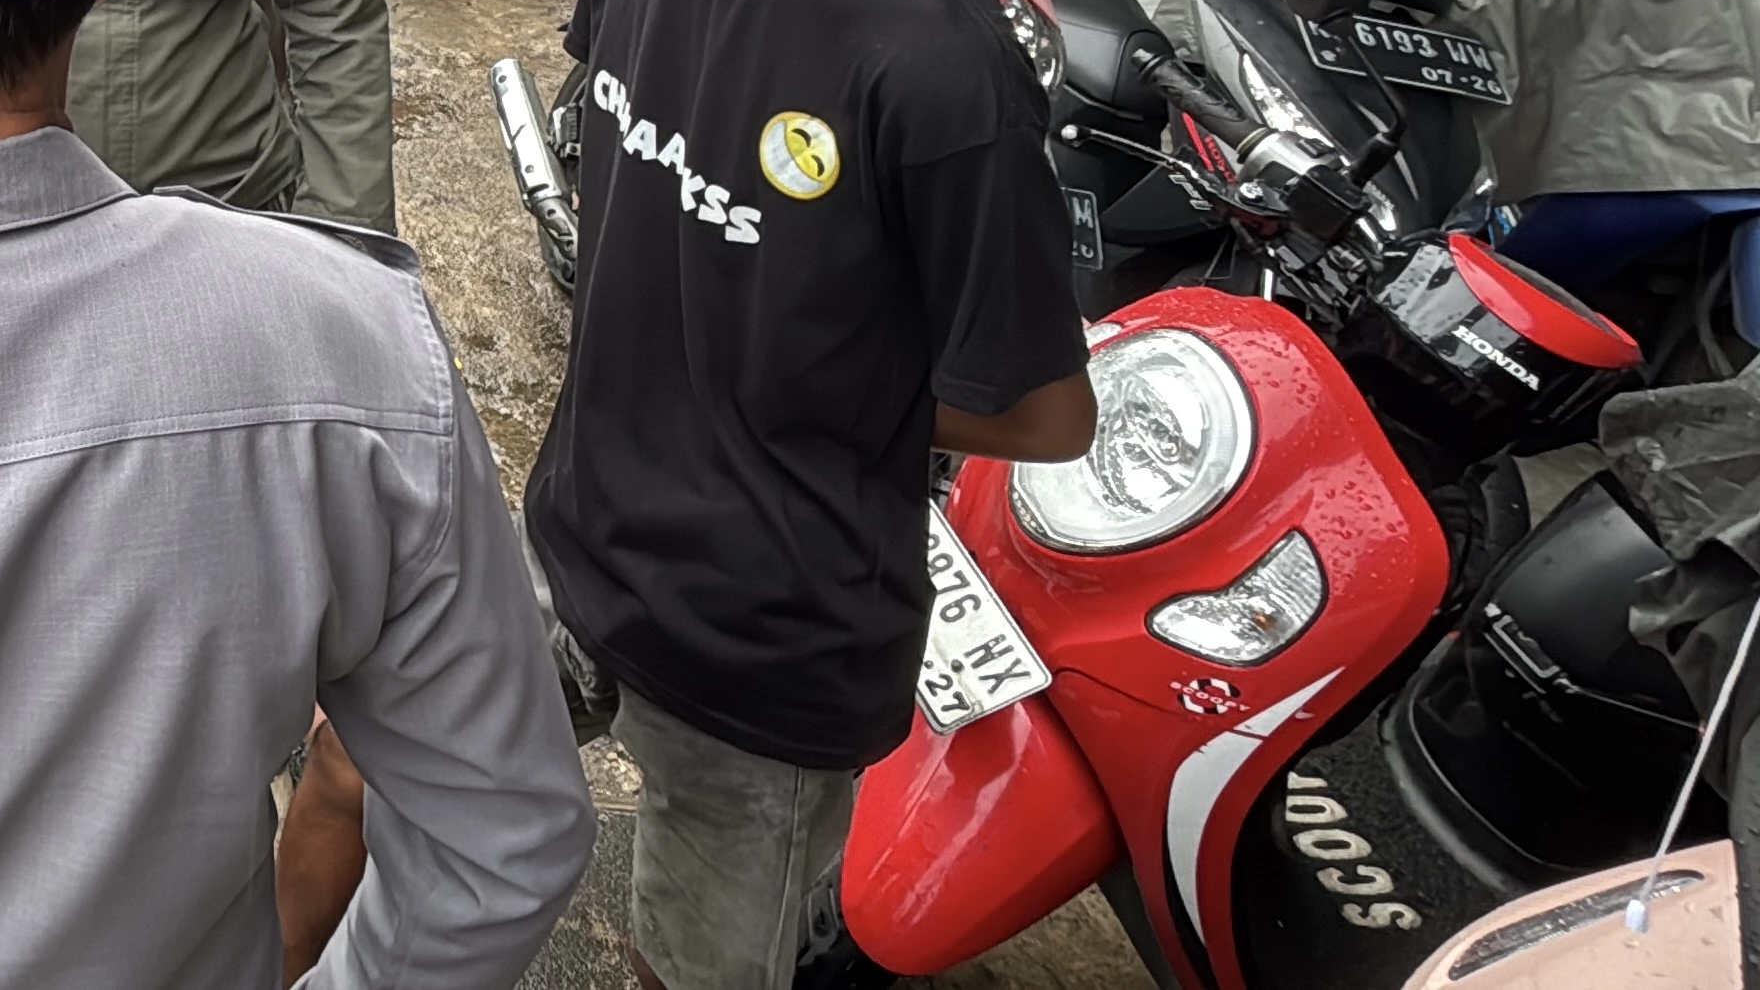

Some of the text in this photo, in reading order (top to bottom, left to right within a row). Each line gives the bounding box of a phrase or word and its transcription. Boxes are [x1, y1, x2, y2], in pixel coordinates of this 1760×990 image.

[1354, 22, 1439, 58] 6193
[1451, 325, 1541, 391] HONDA
[963, 633, 1032, 695] HX
[1169, 681, 1251, 711] SCOOPY
